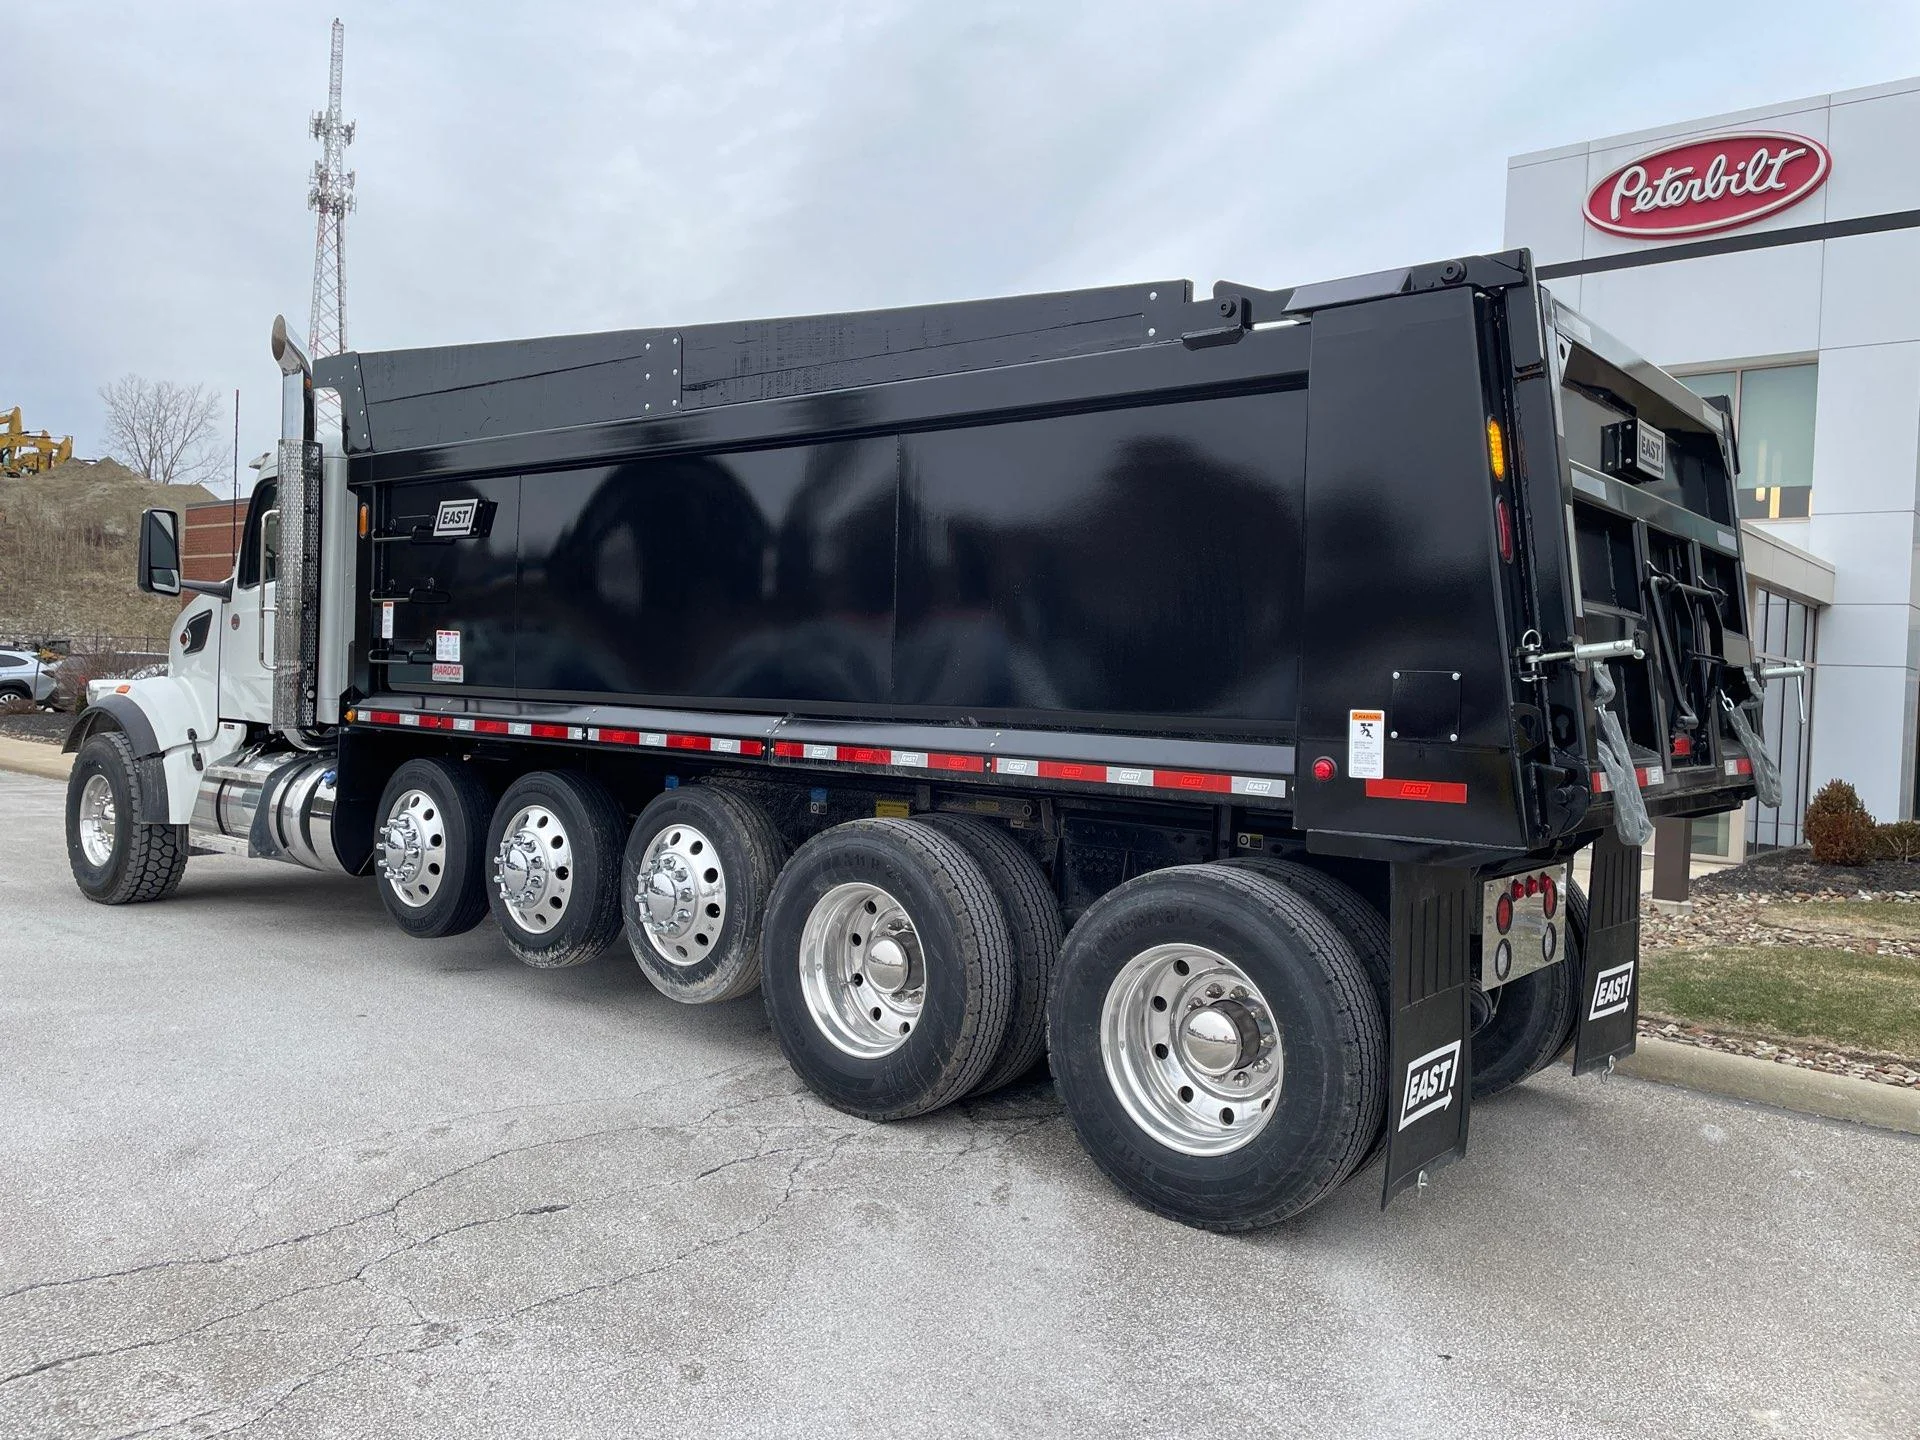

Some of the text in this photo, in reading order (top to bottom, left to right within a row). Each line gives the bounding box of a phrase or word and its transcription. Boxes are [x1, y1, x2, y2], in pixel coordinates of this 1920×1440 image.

[1610, 148, 1806, 221] Peterbilt
[1641, 434, 1661, 461] EAST
[441, 510, 468, 524] EAST
[433, 664, 461, 677] HARDOX
[1248, 783, 1268, 791] EAST
[1403, 785, 1427, 794] EAST
[1596, 974, 1629, 1007] EAST
[1406, 1058, 1452, 1111] EAST
